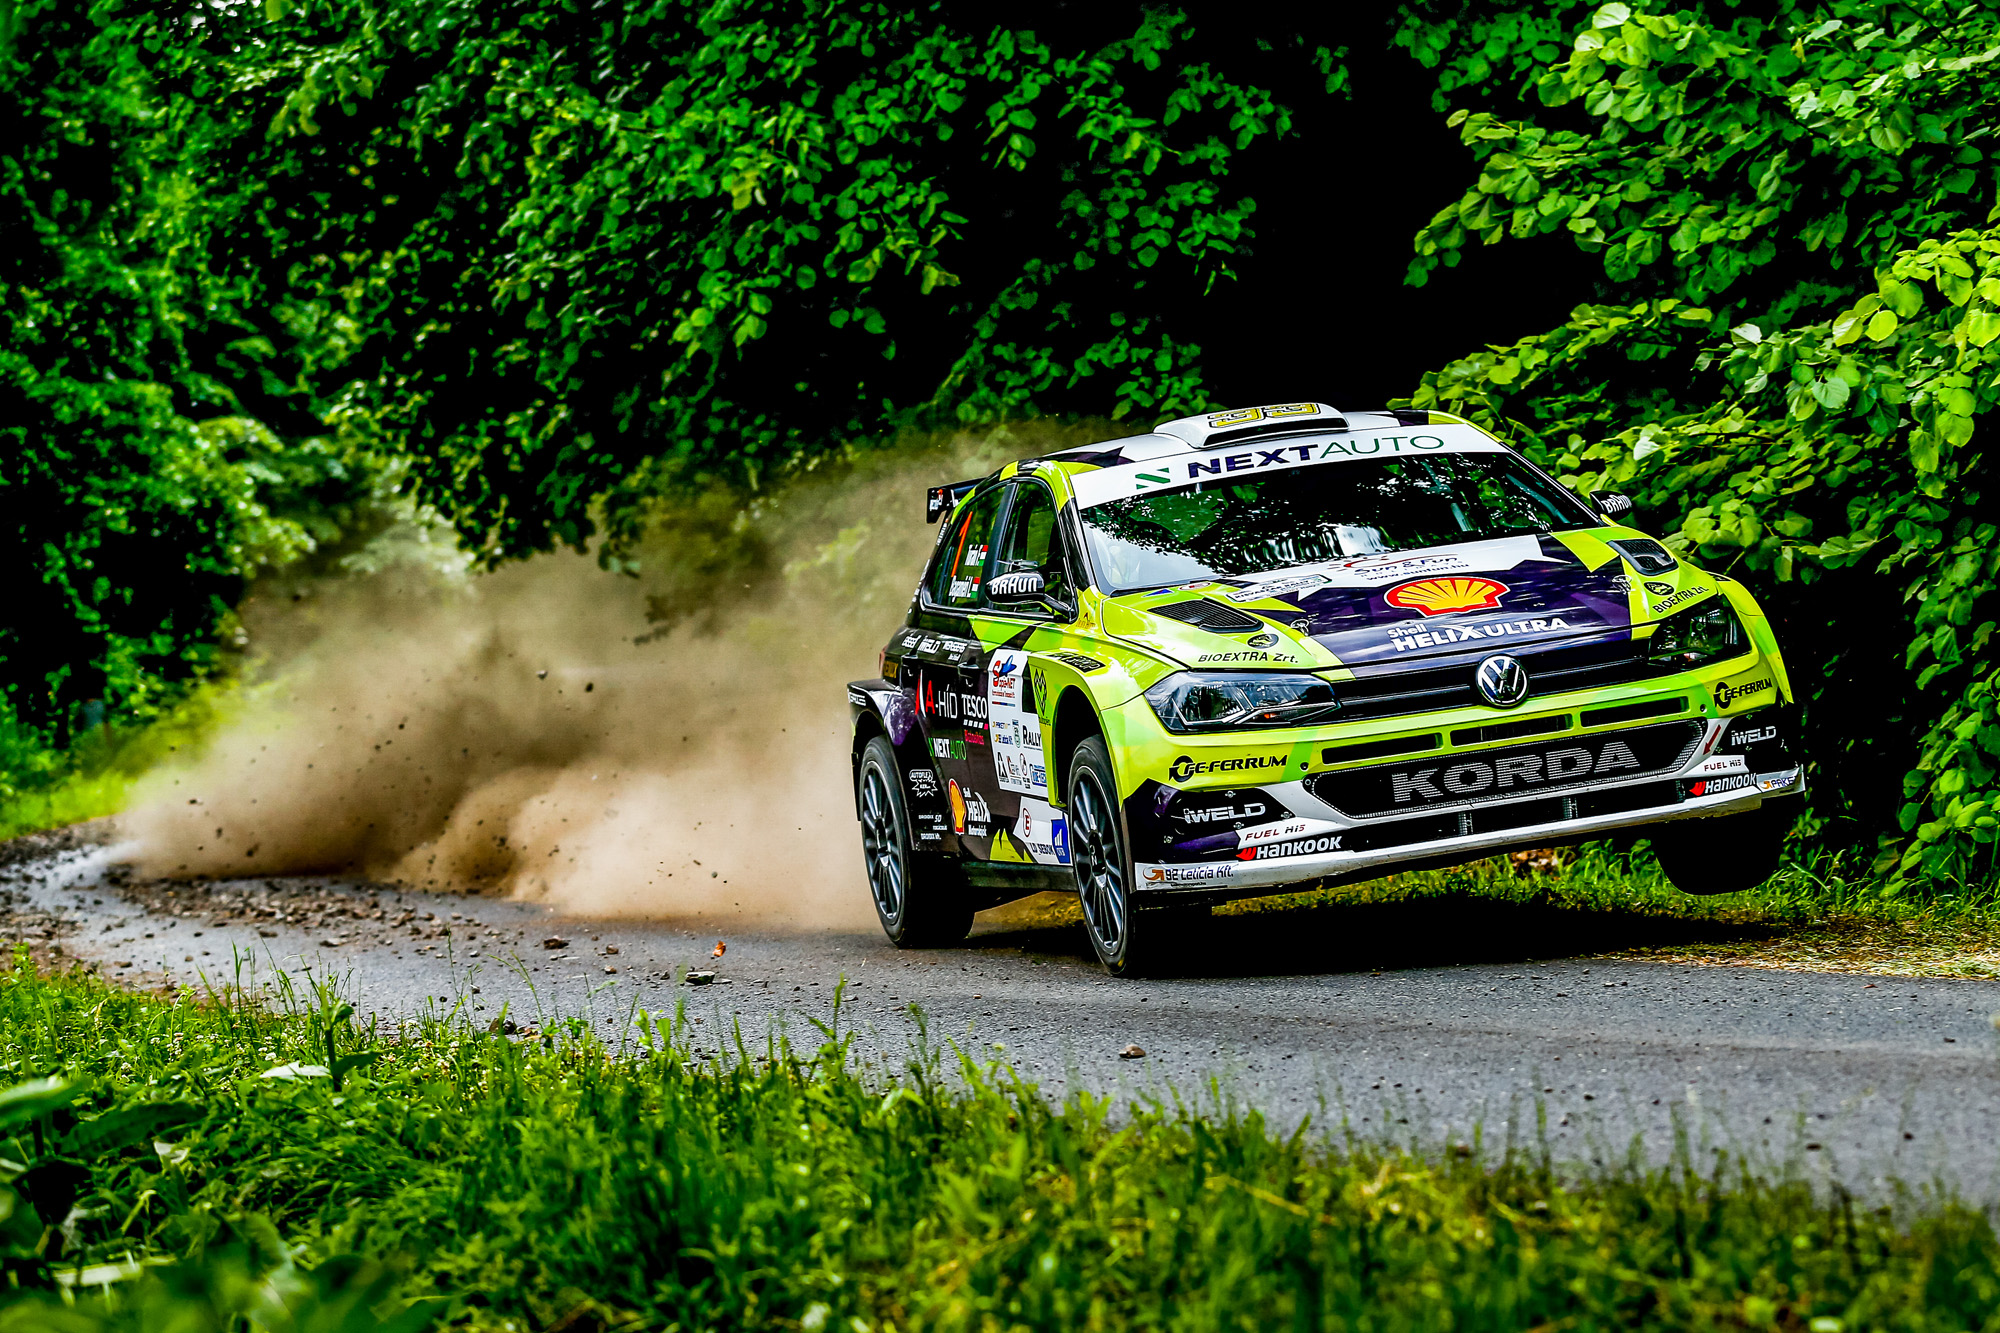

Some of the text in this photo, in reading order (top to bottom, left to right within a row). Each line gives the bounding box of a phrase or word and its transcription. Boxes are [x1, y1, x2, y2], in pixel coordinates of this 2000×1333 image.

[1188, 436, 1444, 478] NEXTAUTO
[951, 511, 973, 577] 1
[991, 576, 1037, 596] BRAUN
[1652, 585, 1709, 613] BIOEXTRA Zrt.
[1387, 623, 1427, 639] Shell
[1390, 617, 1572, 652] HELIX ULTRA
[1198, 651, 1299, 664] BIOEXTRA Zrt.
[961, 694, 988, 719] TESCO
[1022, 725, 1042, 748] RALLY
[1392, 741, 1640, 802] KORDA
[1703, 762, 1727, 772] FUEL
[965, 794, 991, 823] HELIX
[1183, 802, 1266, 824] iWELD
[1245, 828, 1280, 842] FUEL
[1180, 866, 1214, 881] Leticia
[1217, 864, 1234, 878] Kft.
